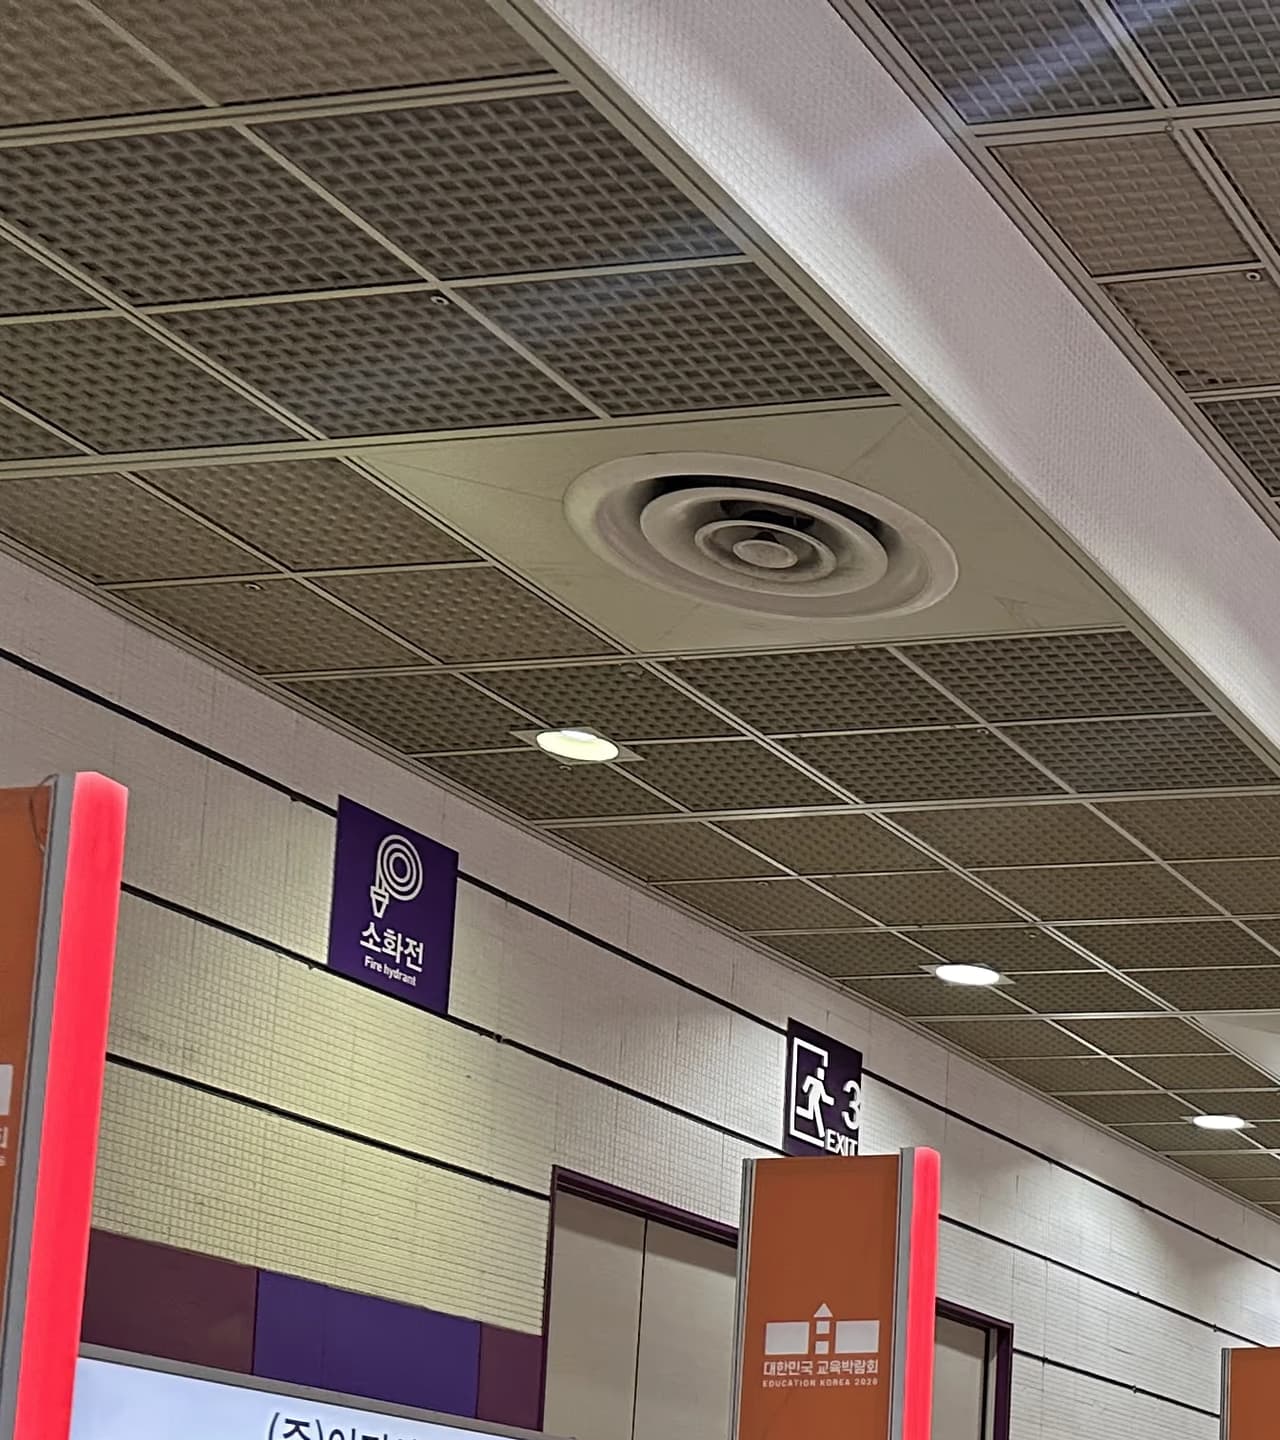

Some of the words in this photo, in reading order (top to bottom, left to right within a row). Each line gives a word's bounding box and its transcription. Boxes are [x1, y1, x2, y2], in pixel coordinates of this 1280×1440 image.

[360, 922, 423, 973] 소화전
[364, 955, 382, 973] Fire
[383, 963, 416, 987] hydrant
[841, 1080, 862, 1130] 3
[826, 1128, 860, 1156] EXIT
[763, 1361, 813, 1376] 대한민국
[816, 1359, 879, 1375] 교육박람회
[762, 1379, 816, 1387] EDUCATION
